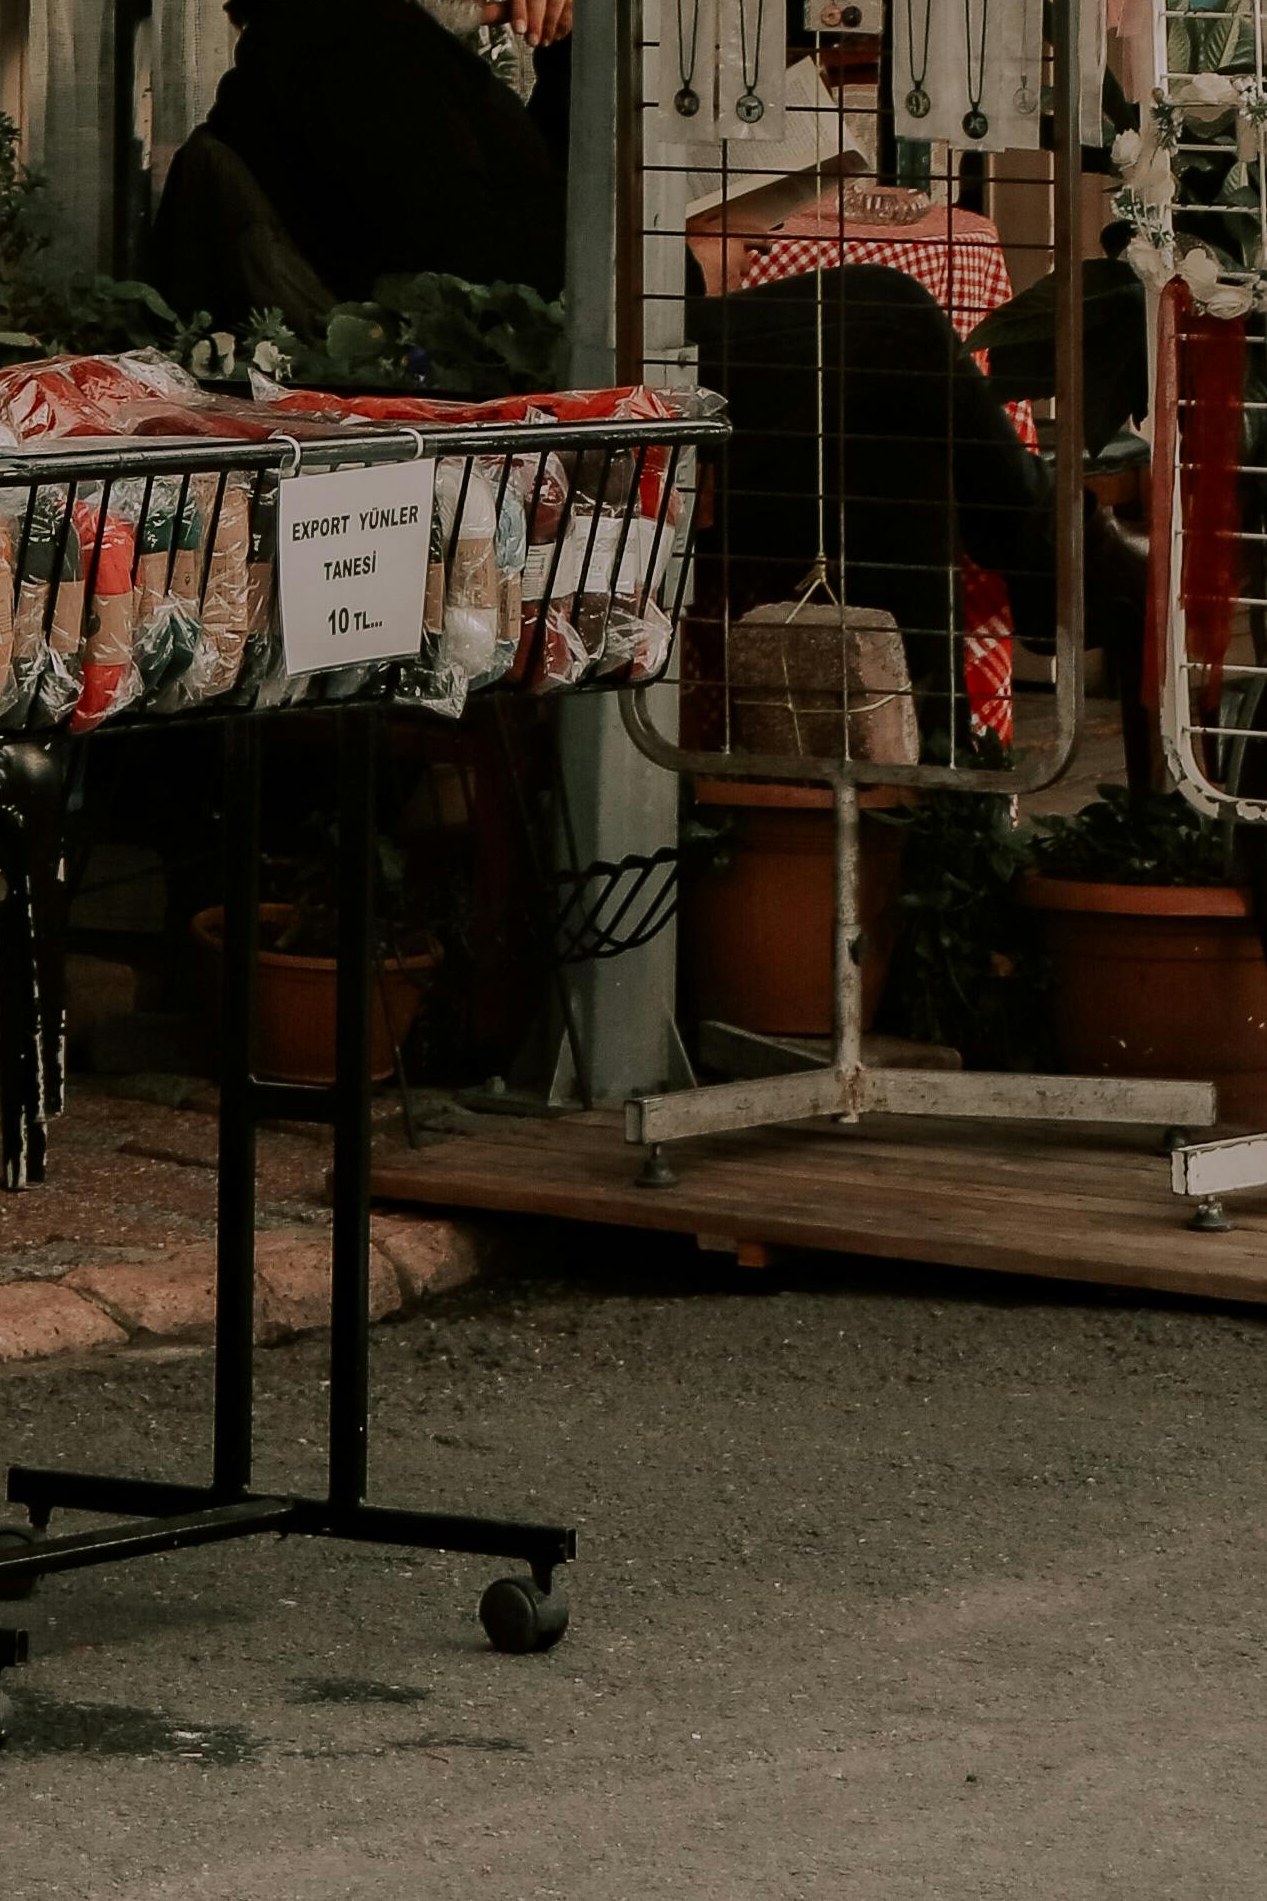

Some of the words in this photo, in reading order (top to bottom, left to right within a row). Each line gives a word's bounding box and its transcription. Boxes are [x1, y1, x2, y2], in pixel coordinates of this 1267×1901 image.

[291, 514, 351, 542] EXPORT
[358, 505, 419, 531] YÜNLER
[323, 549, 377, 581] TANESİ
[327, 607, 350, 636] 10
[354, 611, 383, 631] TL...
